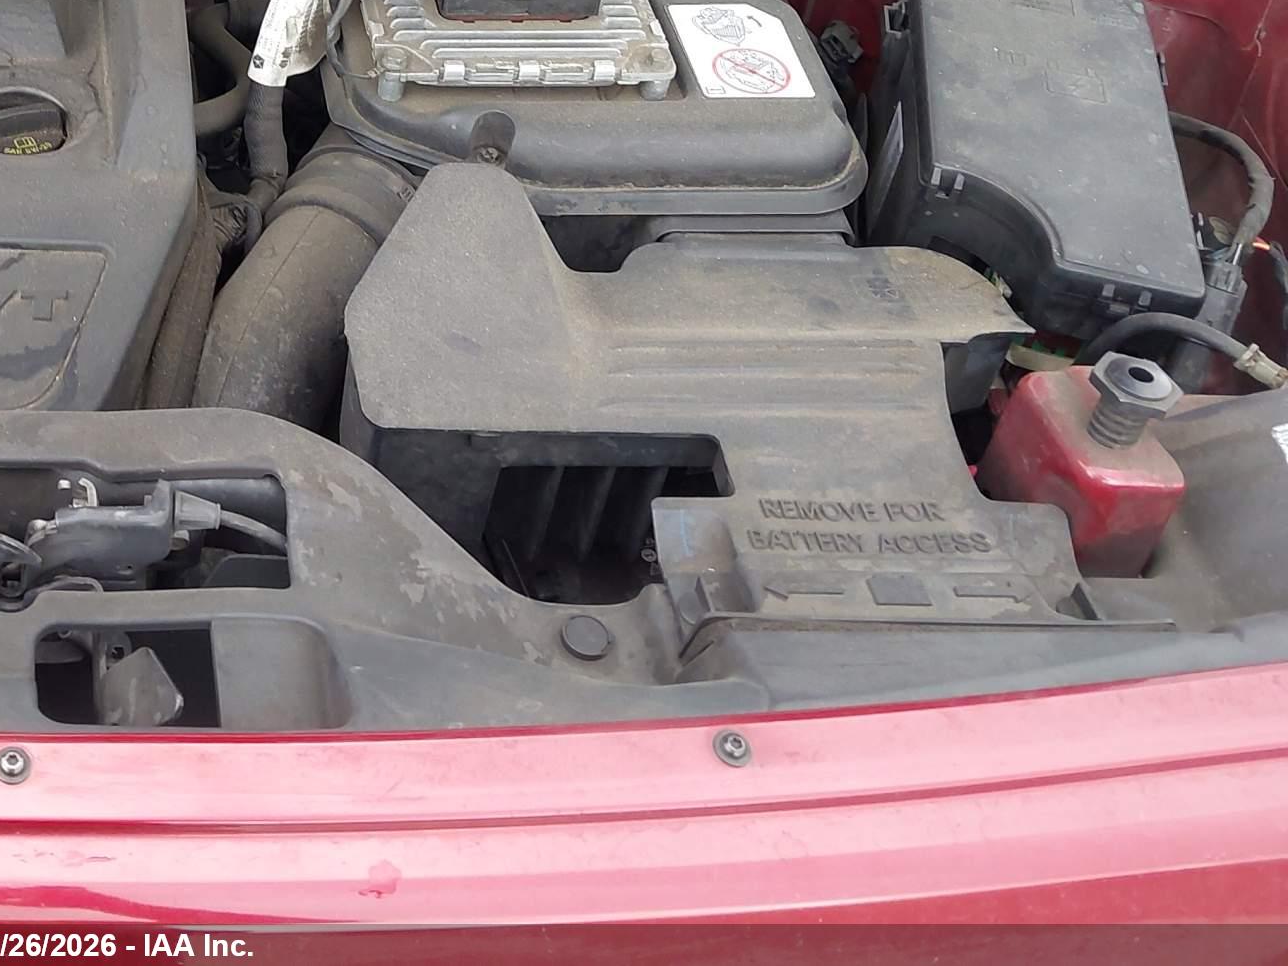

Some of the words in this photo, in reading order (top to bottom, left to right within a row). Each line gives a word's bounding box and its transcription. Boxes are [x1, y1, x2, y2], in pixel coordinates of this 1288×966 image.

[758, 498, 877, 523] REMOVE
[882, 501, 946, 523] FOR
[746, 529, 866, 553] BATTERY
[878, 531, 993, 554] ACCESS
